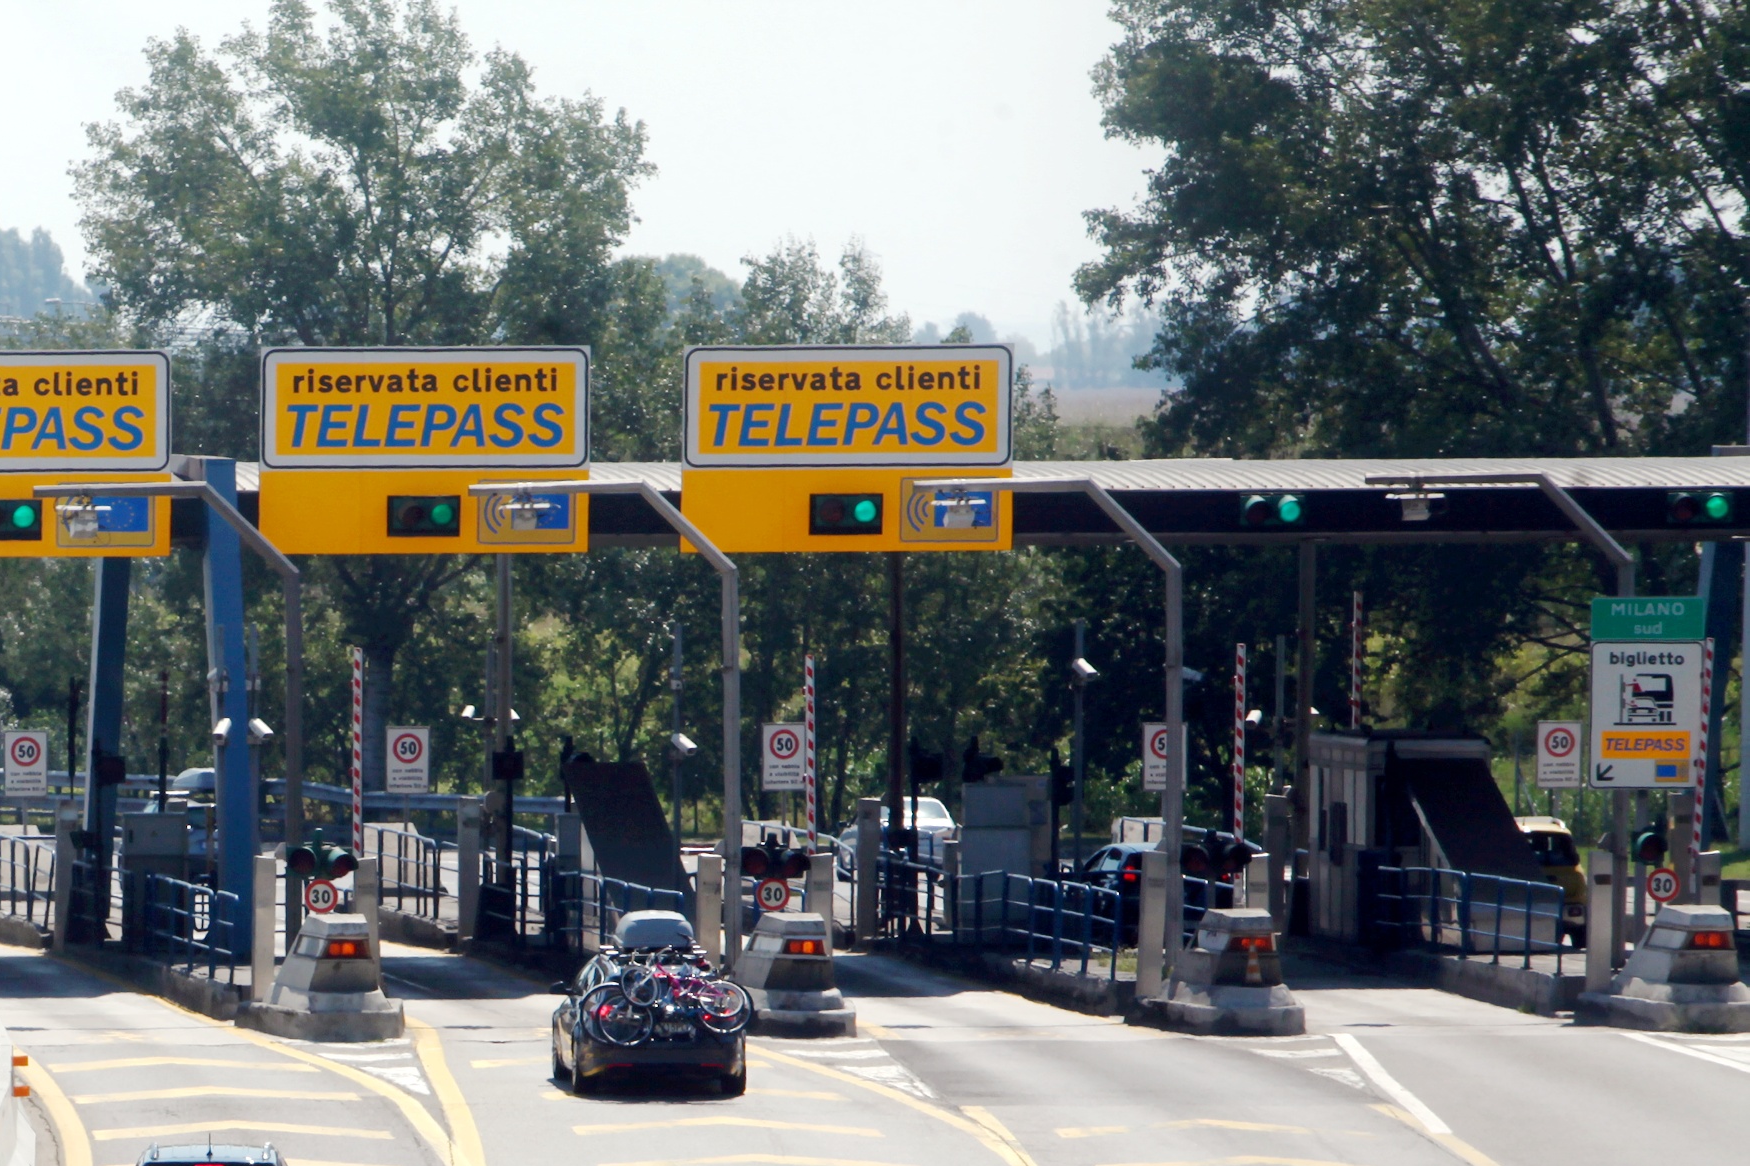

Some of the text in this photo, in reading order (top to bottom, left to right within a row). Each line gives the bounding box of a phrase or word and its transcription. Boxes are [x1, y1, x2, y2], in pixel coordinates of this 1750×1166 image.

[34, 371, 139, 396] clienti
[293, 367, 557, 393] riservata clienti
[716, 365, 980, 391] riservata clienti
[286, 402, 565, 448] TELEPASS
[709, 401, 986, 447] TELEPASS
[1610, 602, 1685, 617] MILANO
[1634, 622, 1663, 635] sud
[1609, 651, 1685, 667] biglietto
[400, 741, 417, 756] 50
[776, 737, 793, 752] 50
[1551, 736, 1569, 749] 50
[1605, 737, 1686, 752] TELEPASS
[18, 745, 35, 758] 50
[1653, 877, 1673, 893] 30
[311, 889, 331, 904] 30
[764, 887, 783, 902] 30
